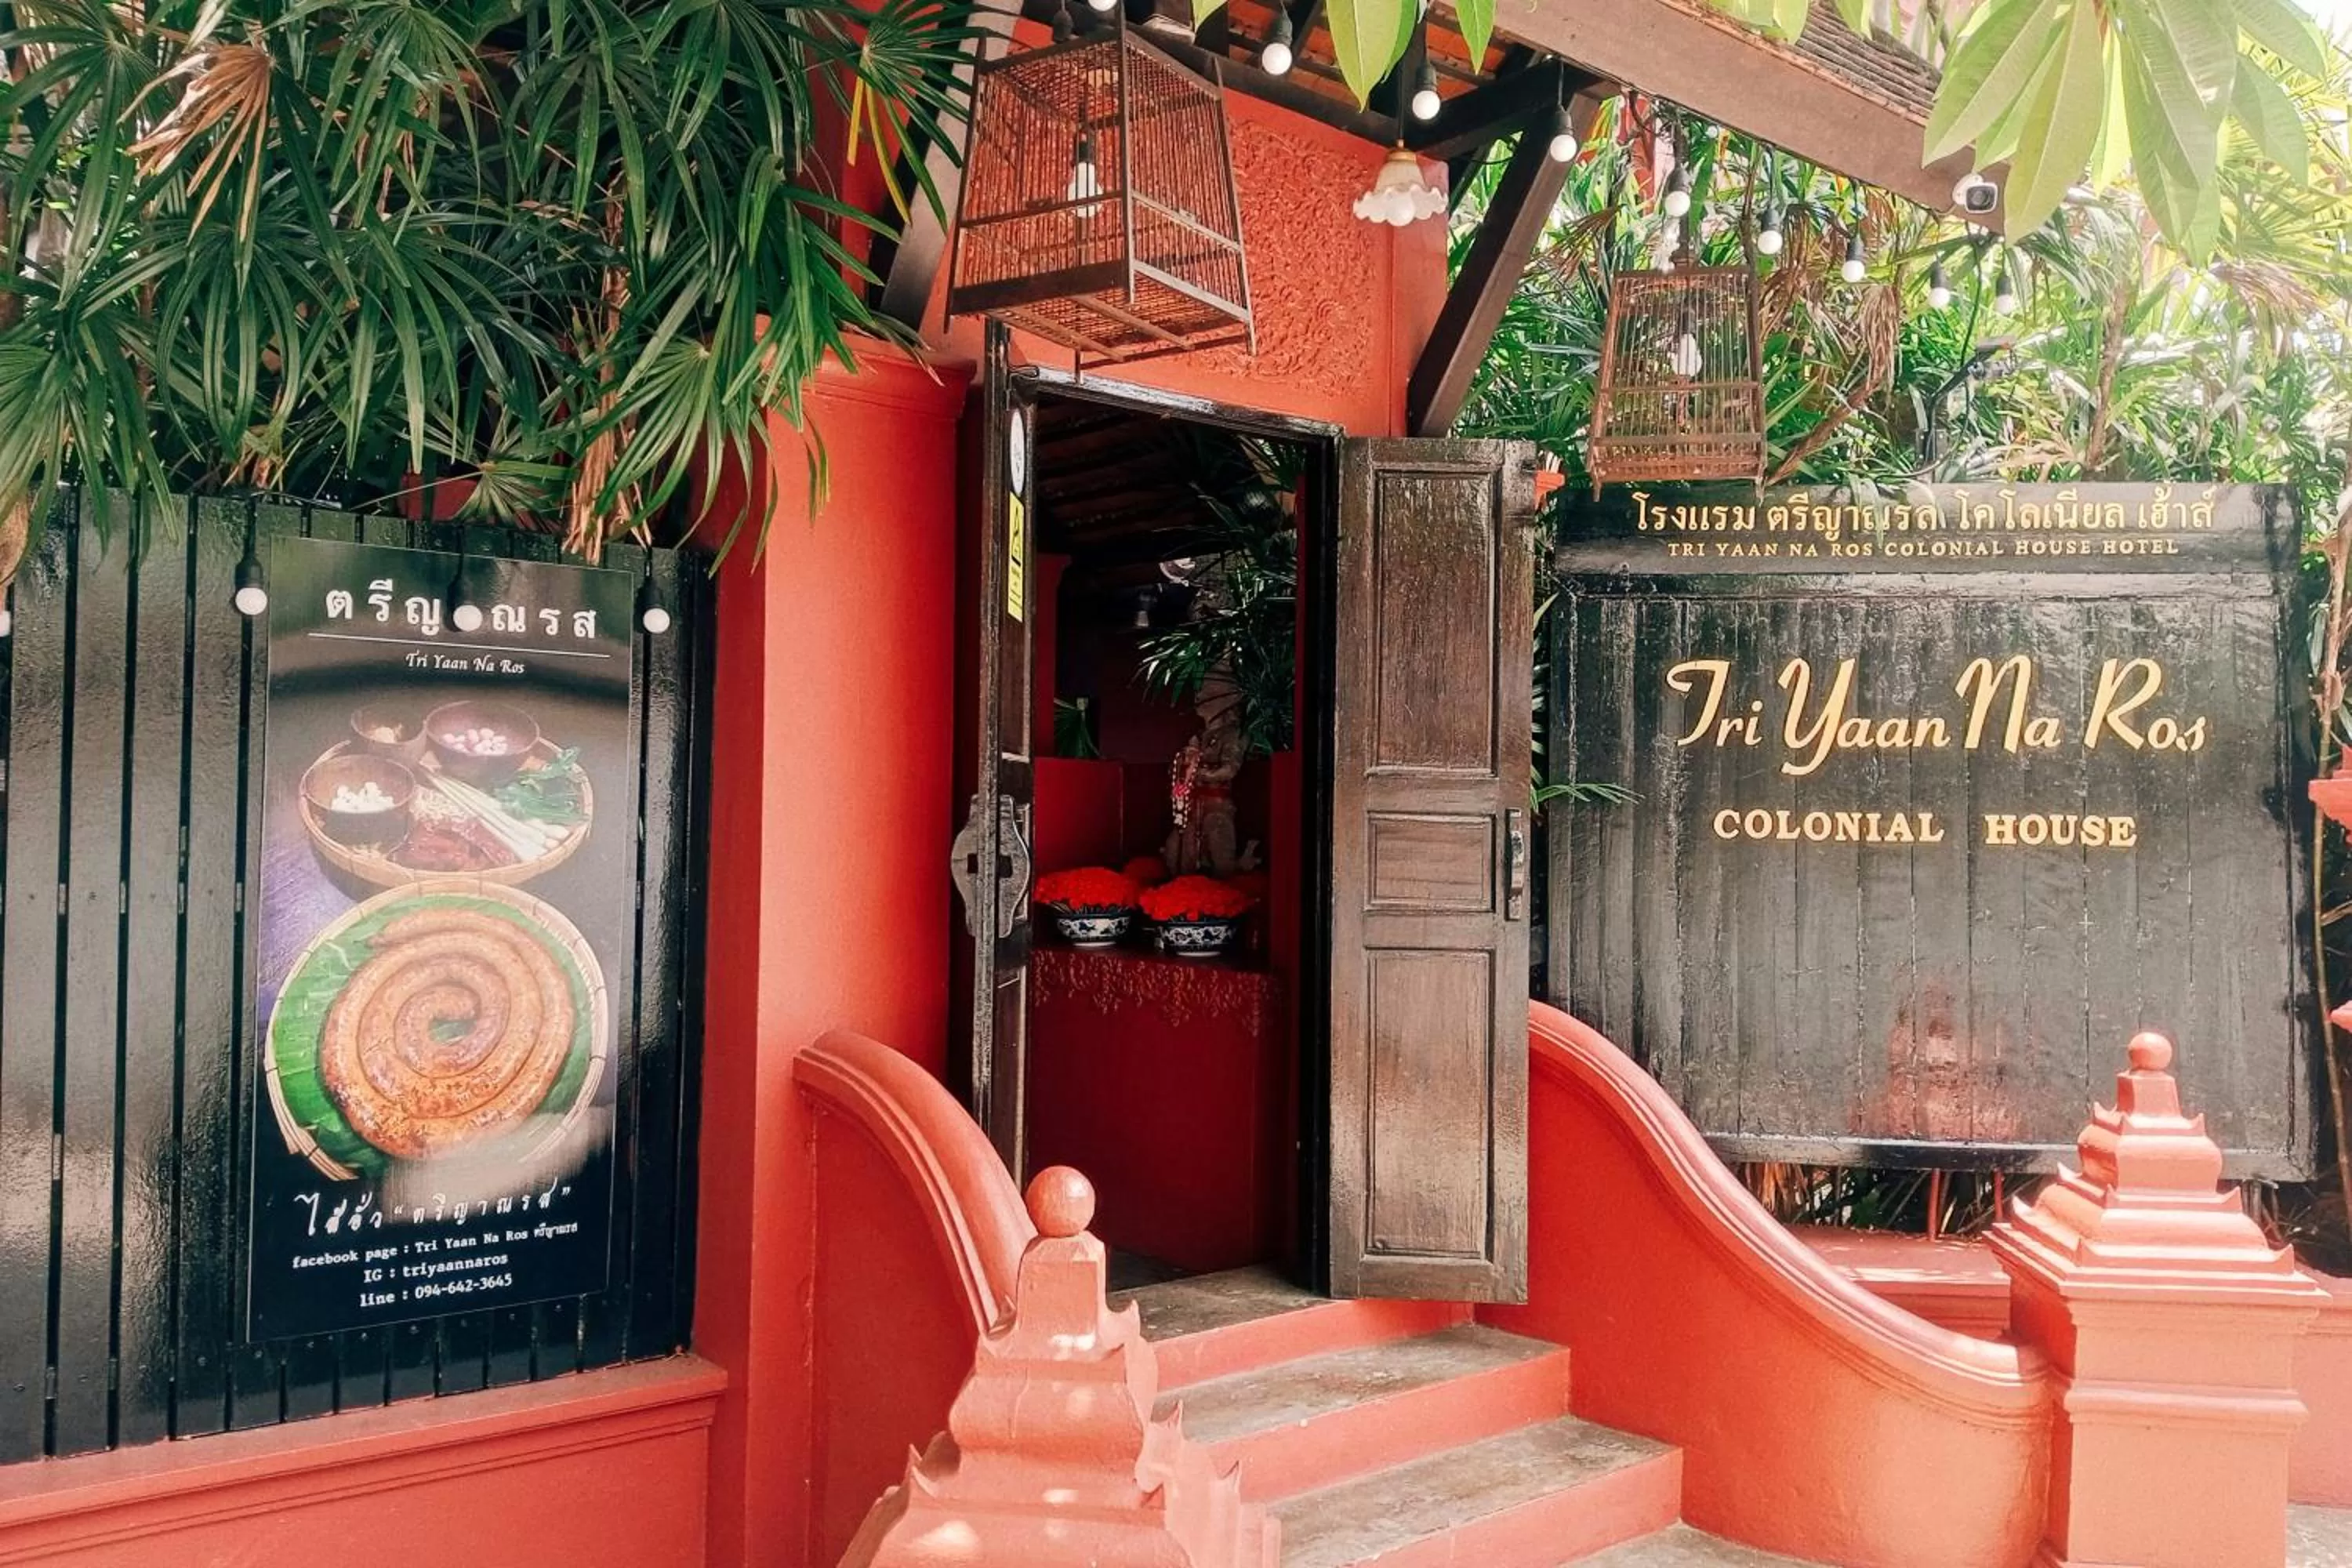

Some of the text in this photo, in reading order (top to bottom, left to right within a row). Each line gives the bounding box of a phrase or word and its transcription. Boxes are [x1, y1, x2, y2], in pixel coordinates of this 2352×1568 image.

[1632, 491, 1755, 532] โรงแรม
[2138, 484, 2217, 530] เฮ้าส์
[1668, 539, 2180, 557] TRI YAAN NA ROS COLONIAL HOUSE HOTEL
[325, 579, 597, 639] ตรีญณรส
[405, 649, 525, 674] Tri Yaan Na Ros
[1666, 655, 2208, 776] Tri Yaan Na Ros
[1713, 808, 2138, 848] COLONIAL HOUSE
[292, 1250, 358, 1269] facebook
[365, 1247, 397, 1262] page
[415, 1240, 438, 1254] Tri
[445, 1236, 477, 1250] Yaan
[483, 1232, 499, 1245] Na
[506, 1229, 528, 1242] Ros
[363, 1268, 383, 1283] IG
[402, 1254, 509, 1278] triyaannaros
[360, 1293, 395, 1307] line
[415, 1272, 513, 1300] 094-642-3645
